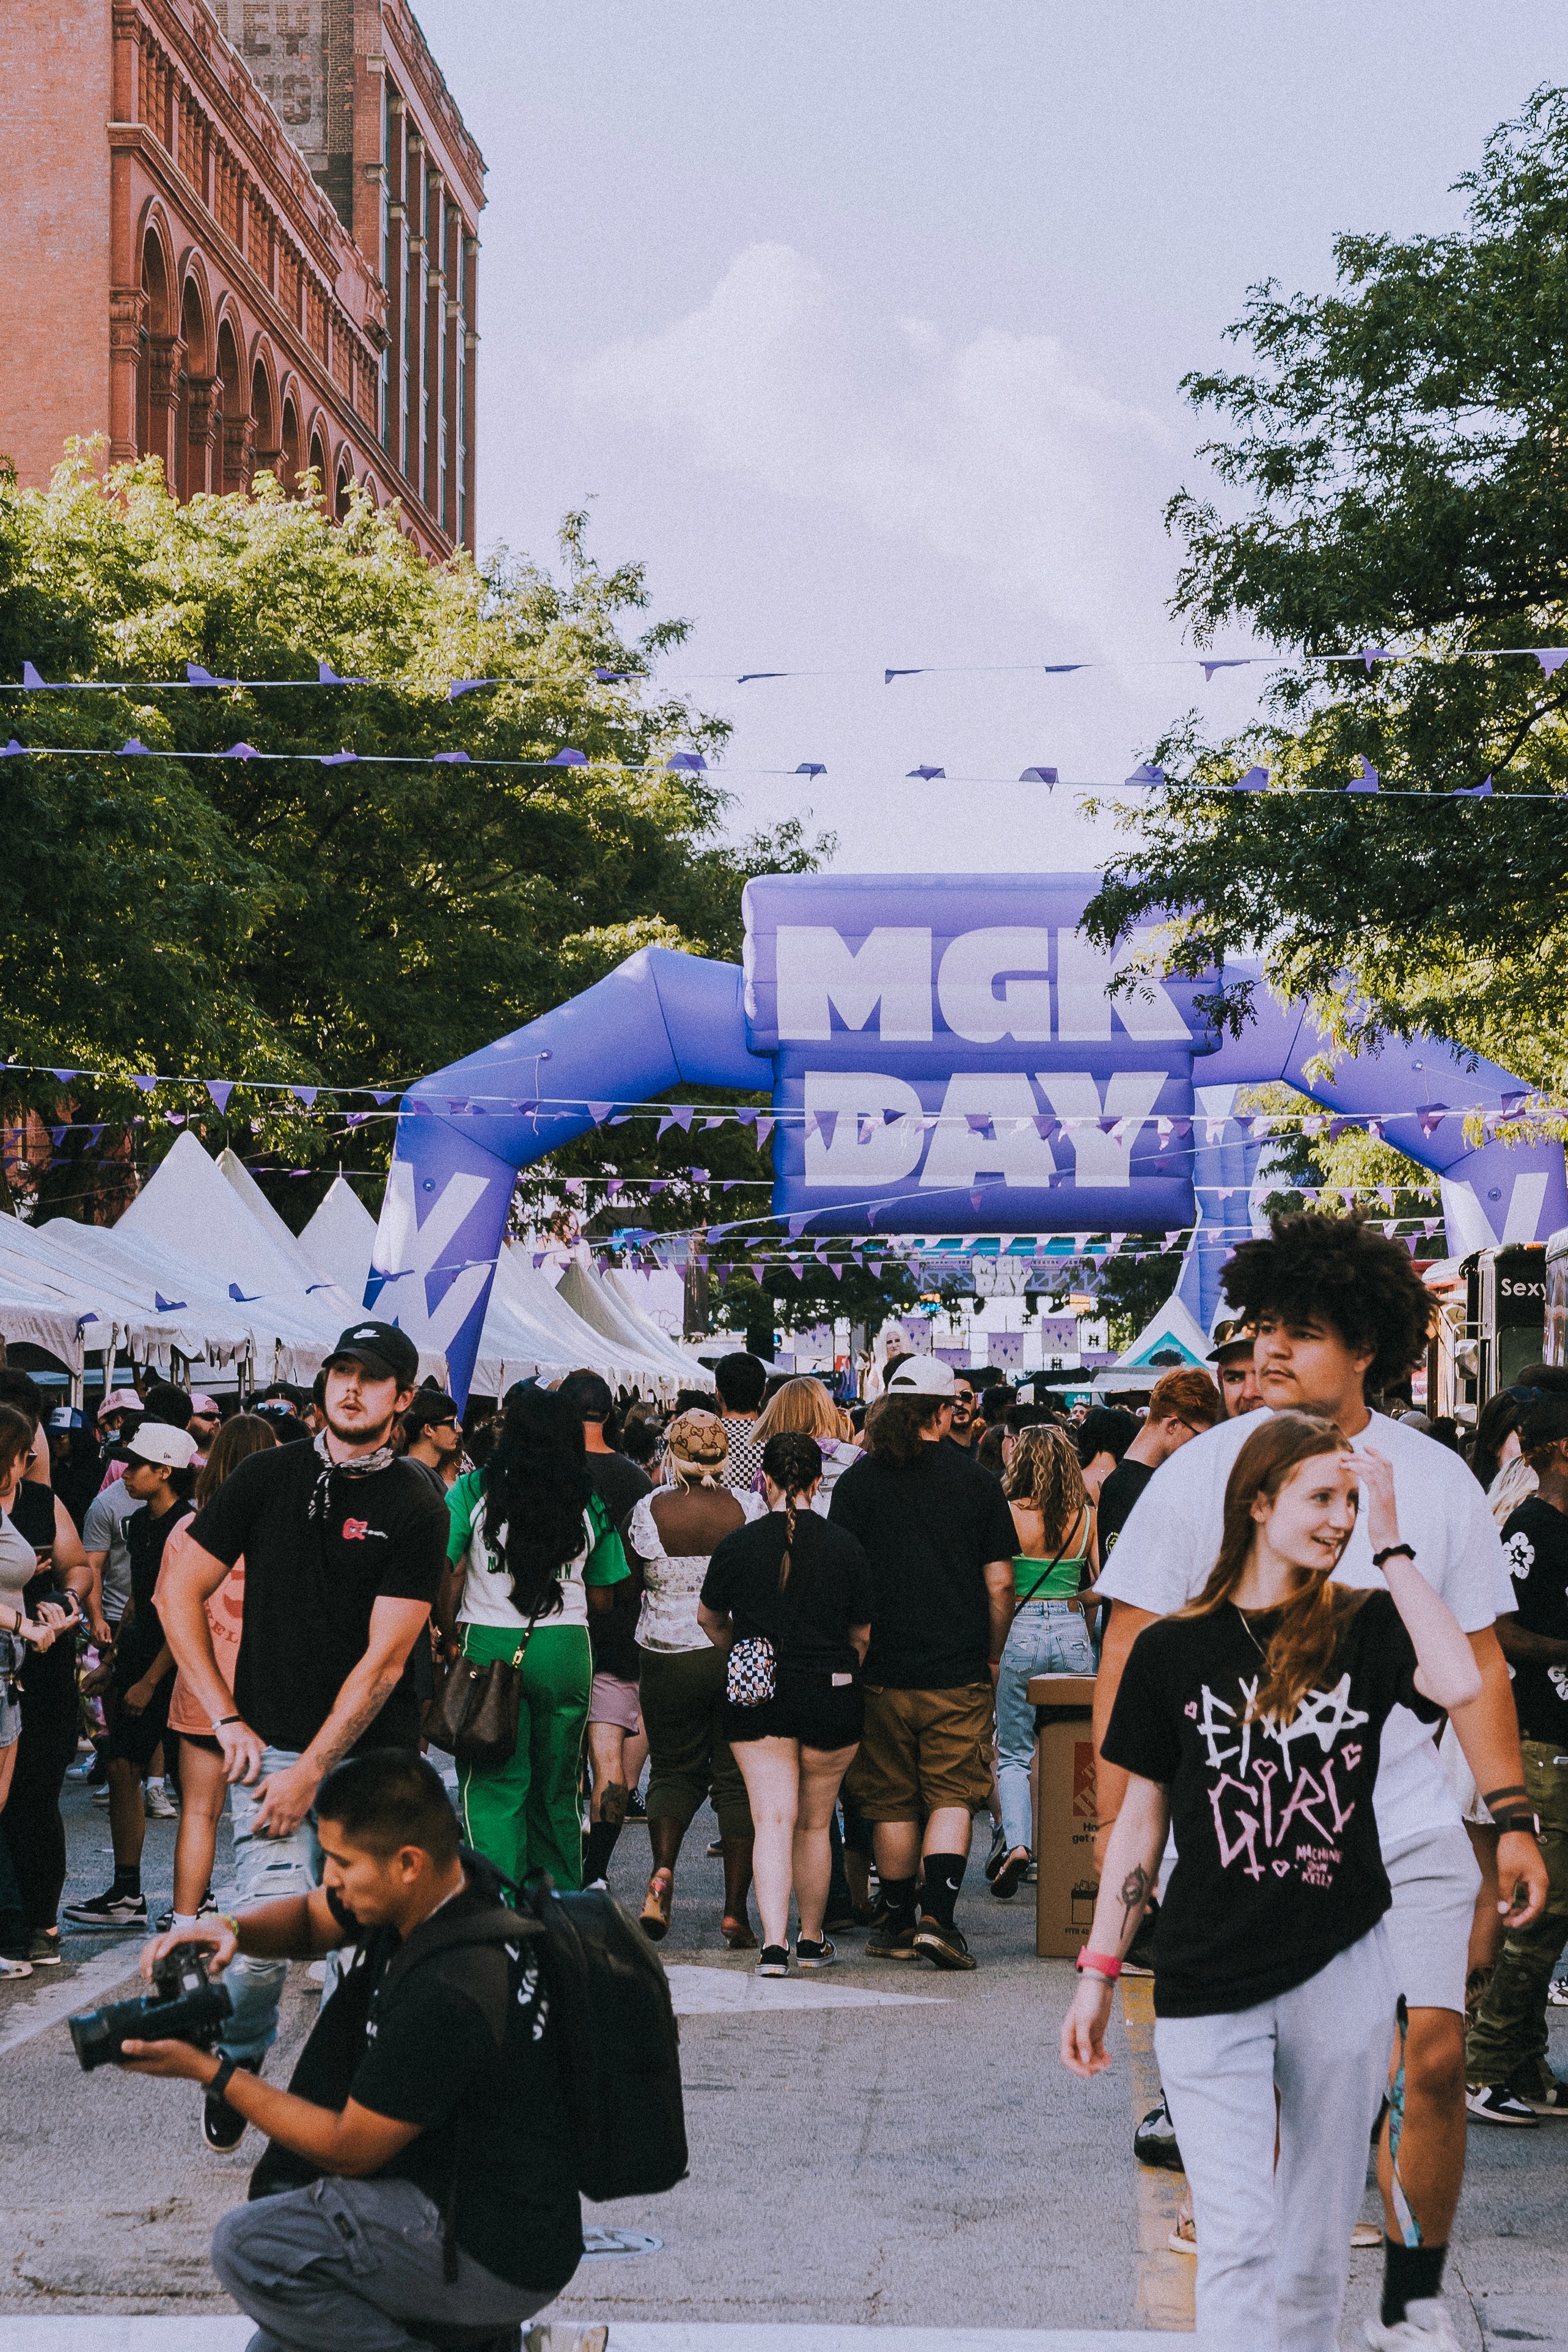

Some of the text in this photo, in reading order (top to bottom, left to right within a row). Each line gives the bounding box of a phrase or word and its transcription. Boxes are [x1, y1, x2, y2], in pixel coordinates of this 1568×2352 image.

[776, 925, 1192, 1043] MGK
[804, 1071, 1169, 1188] DAY
[1207, 1757, 1355, 1881] GIRL
